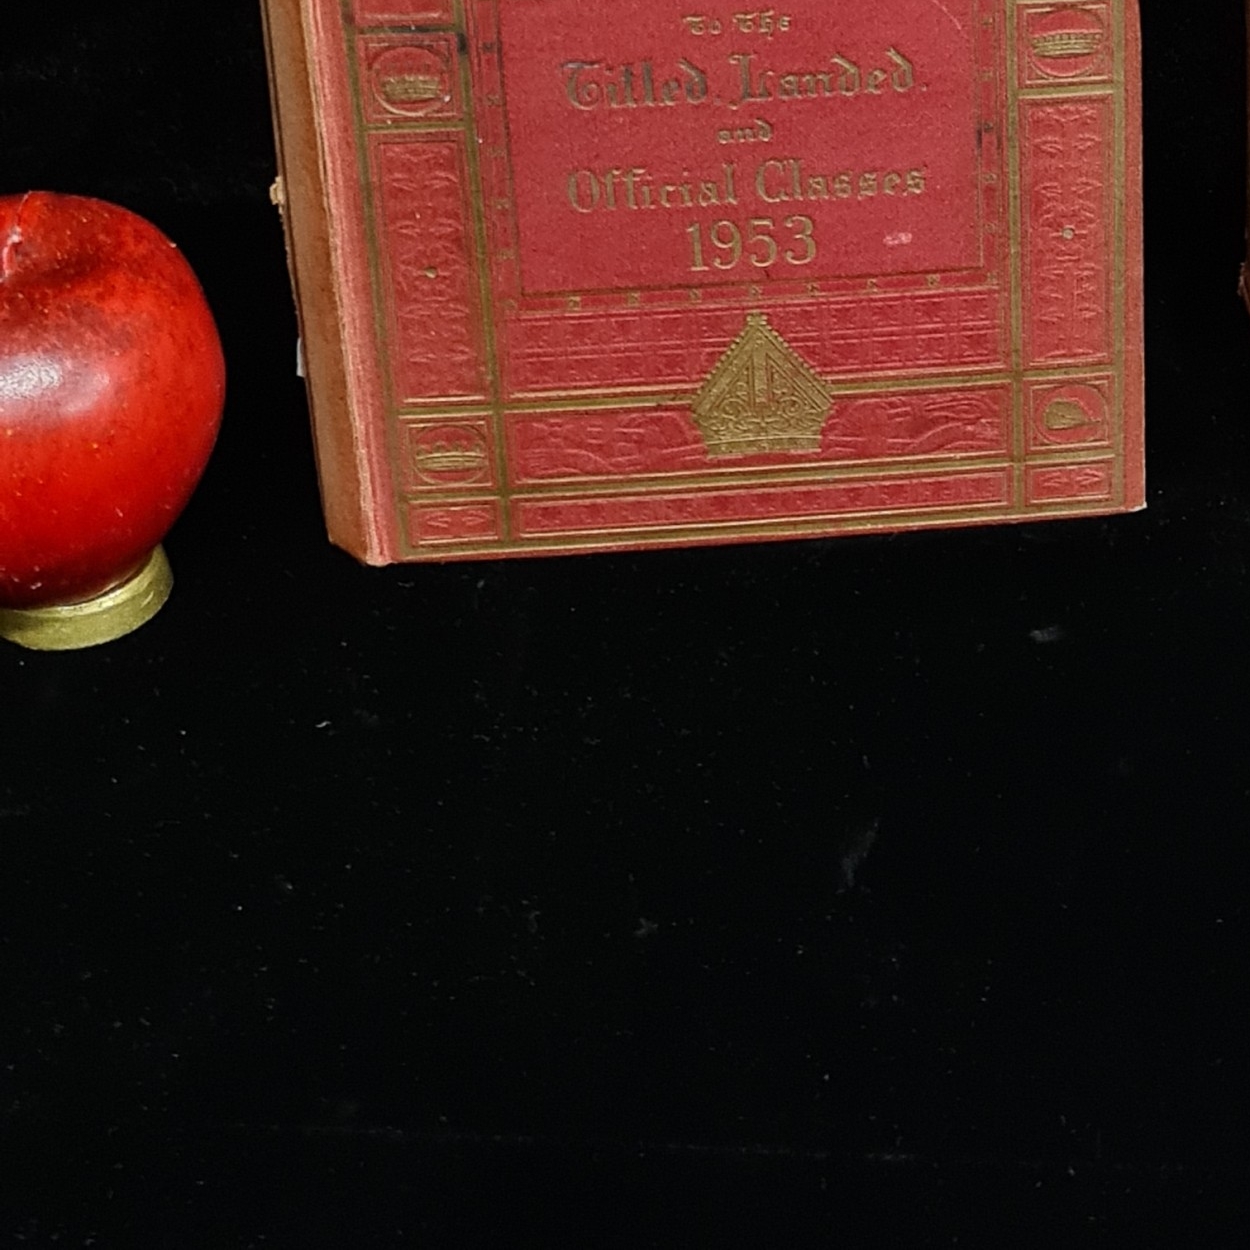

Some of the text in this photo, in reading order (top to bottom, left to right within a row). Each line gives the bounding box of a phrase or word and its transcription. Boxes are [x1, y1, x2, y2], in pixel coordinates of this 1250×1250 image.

[717, 118, 773, 144] and
[566, 158, 928, 213] Official Classes
[685, 215, 818, 273] 1953
